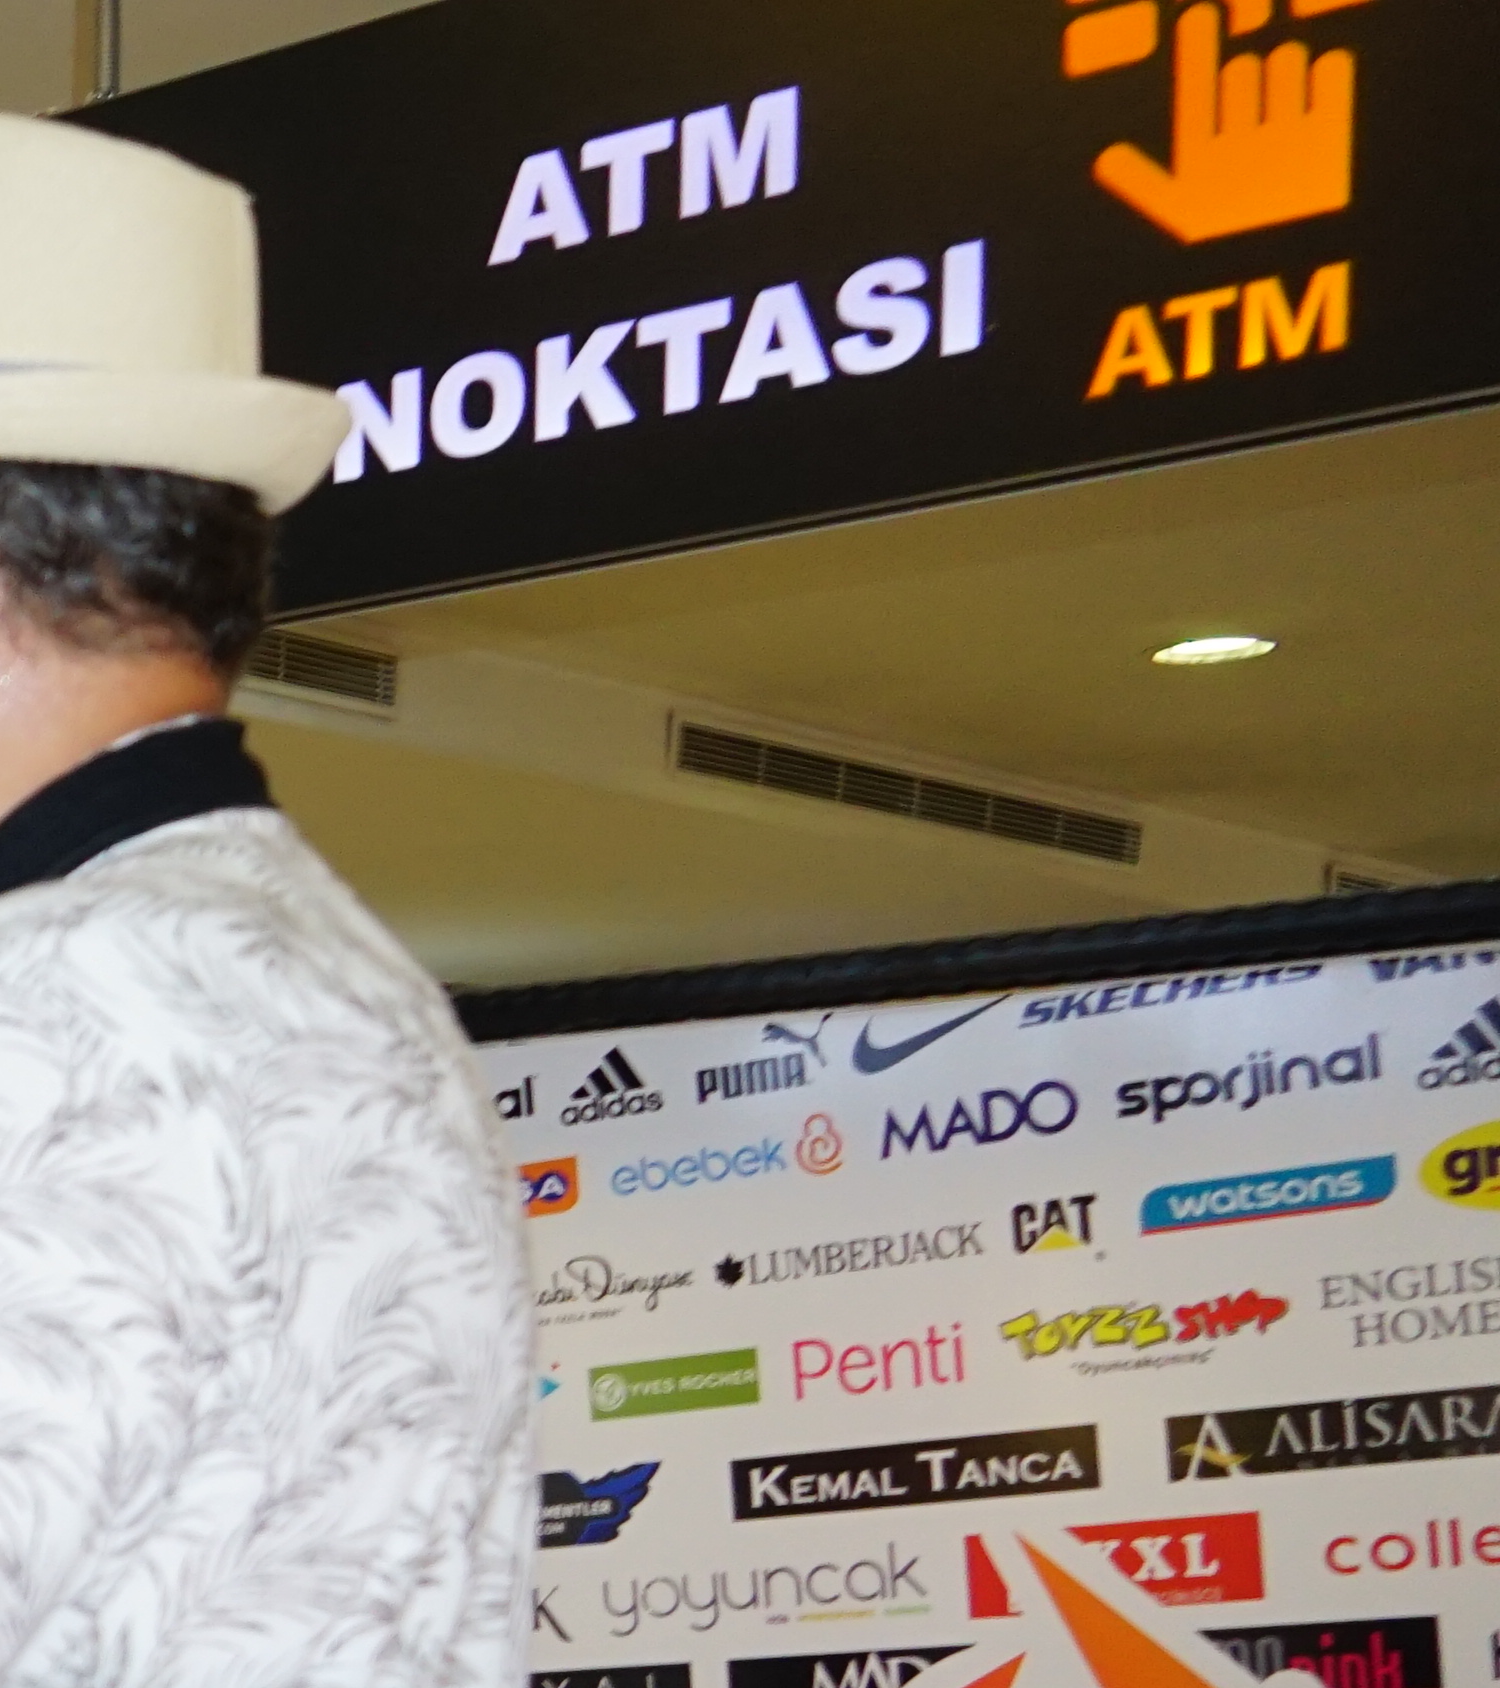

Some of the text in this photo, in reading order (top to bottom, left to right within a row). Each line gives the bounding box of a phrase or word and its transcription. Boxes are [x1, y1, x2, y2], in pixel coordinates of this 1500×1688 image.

[487, 84, 802, 267] ATM
[332, 239, 989, 484] NOKTASI
[1085, 260, 1354, 402] ATM
[560, 1091, 666, 1127] adidas
[696, 1052, 806, 1106] PUMA
[1117, 1032, 1383, 1124] sporjinal
[881, 1080, 1080, 1161] MADO
[611, 1137, 788, 1198] ebebek
[1169, 1166, 1365, 1221] watsons
[746, 1220, 986, 1287] LUMBERJACK
[1011, 1193, 1097, 1255] CAT
[1318, 1254, 1500, 1312] ENGLIS
[1351, 1299, 1500, 1349] HOME
[791, 1322, 965, 1401] Penti
[748, 1447, 1084, 1510] KEMAL TANCA
[602, 1541, 928, 1638] yoyuncak
